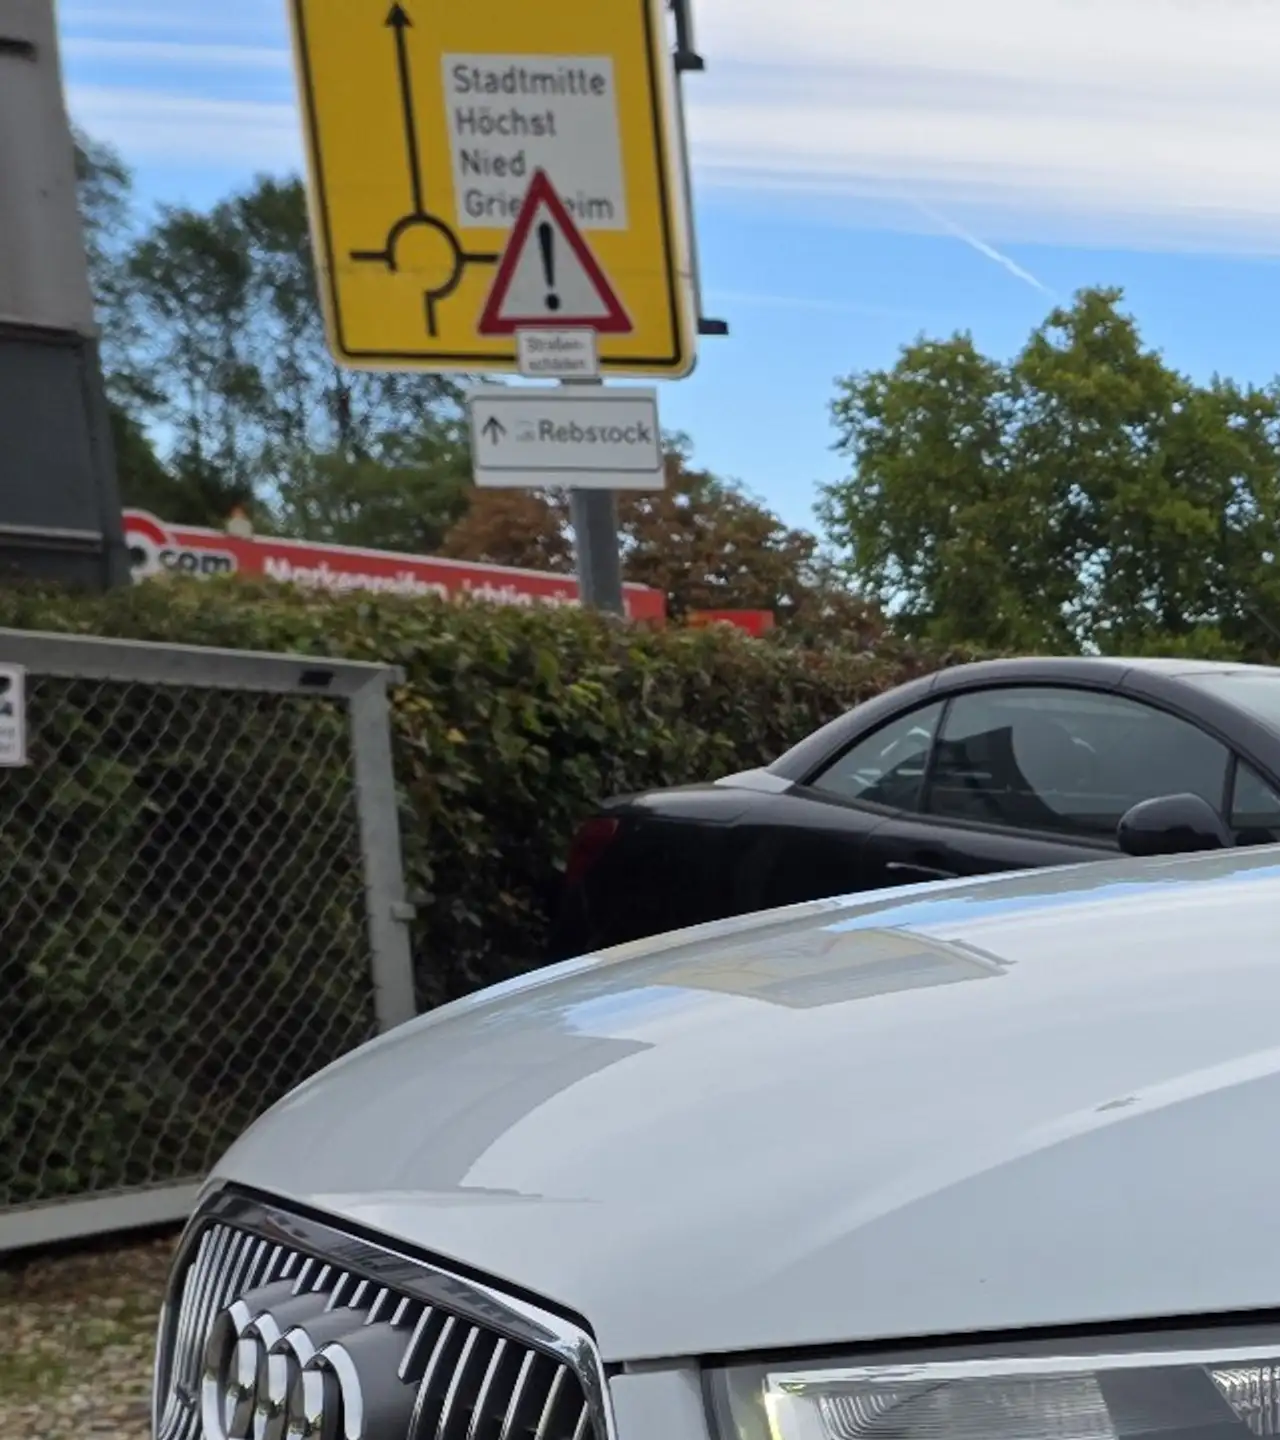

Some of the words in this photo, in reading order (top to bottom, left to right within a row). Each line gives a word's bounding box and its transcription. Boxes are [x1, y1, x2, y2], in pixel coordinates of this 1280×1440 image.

[452, 65, 607, 96] Stadtmitte
[454, 108, 556, 137] Höchst
[459, 149, 527, 177] Nied
[538, 420, 652, 445] Rebstock
